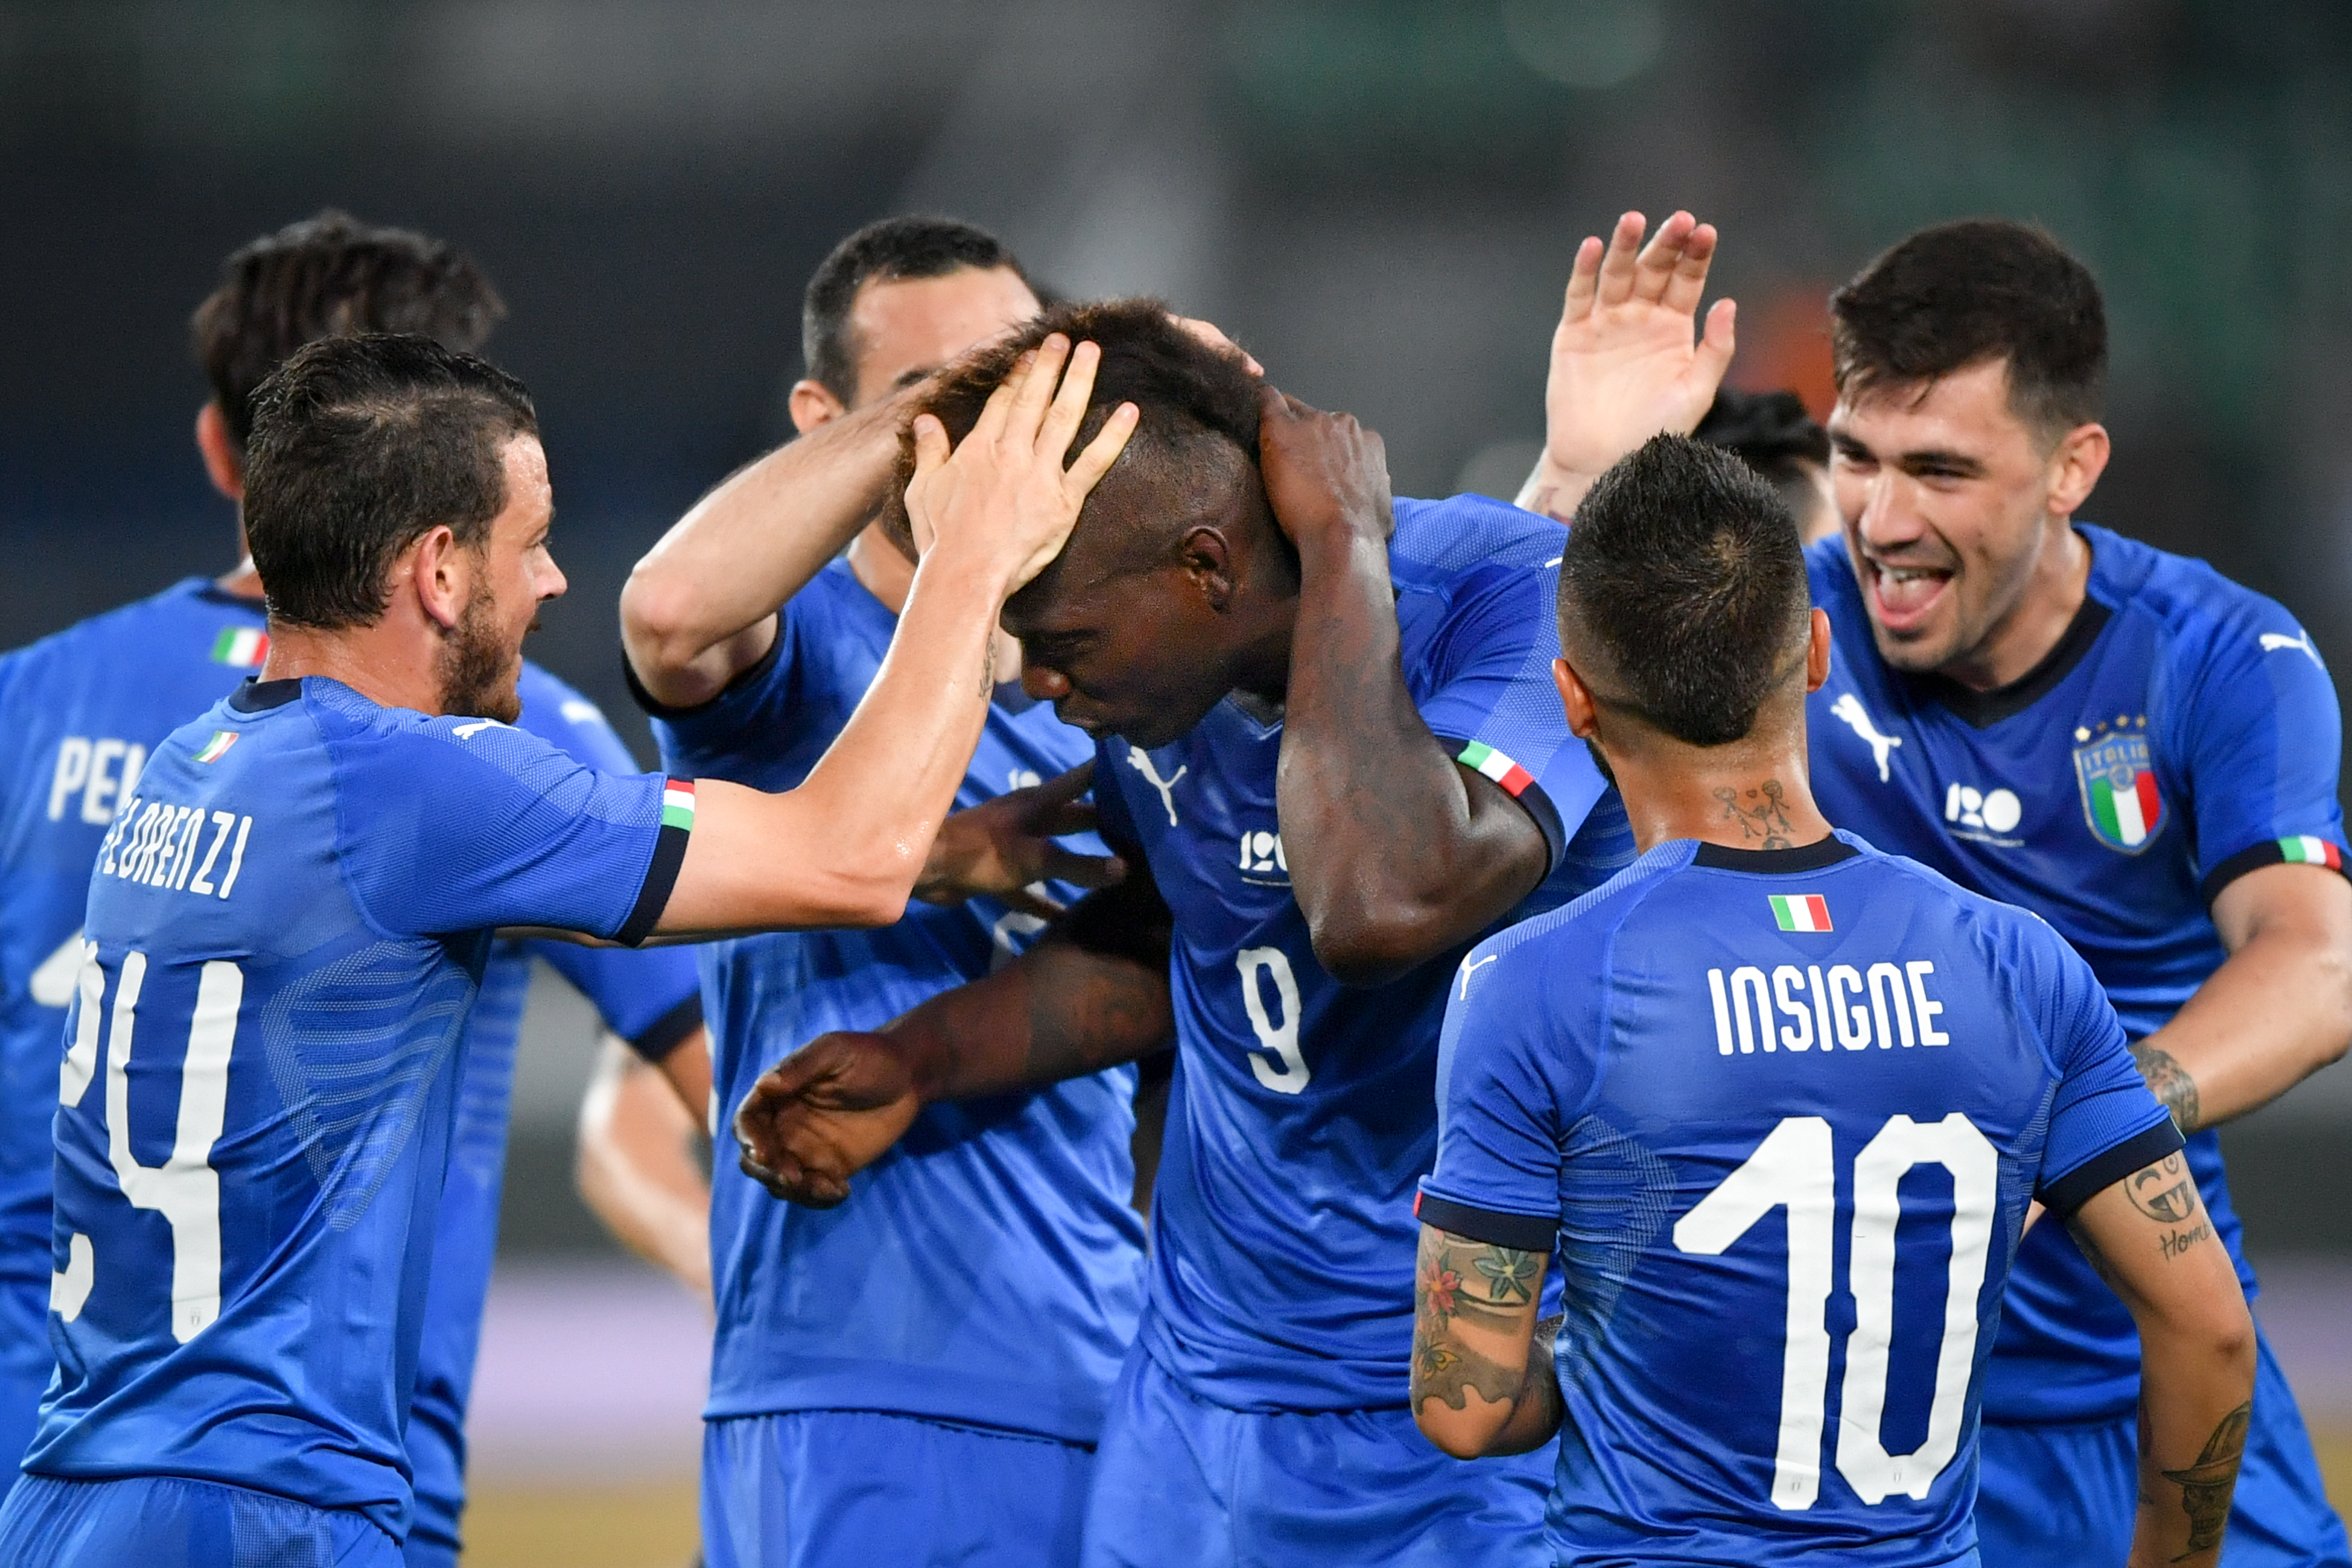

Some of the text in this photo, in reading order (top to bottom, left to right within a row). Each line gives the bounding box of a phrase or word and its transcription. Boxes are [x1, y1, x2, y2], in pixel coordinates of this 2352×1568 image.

[1236, 946, 1311, 1094] 9
[1707, 960, 1950, 1055] INSIGNE
[1673, 1112, 1999, 1511] 10
